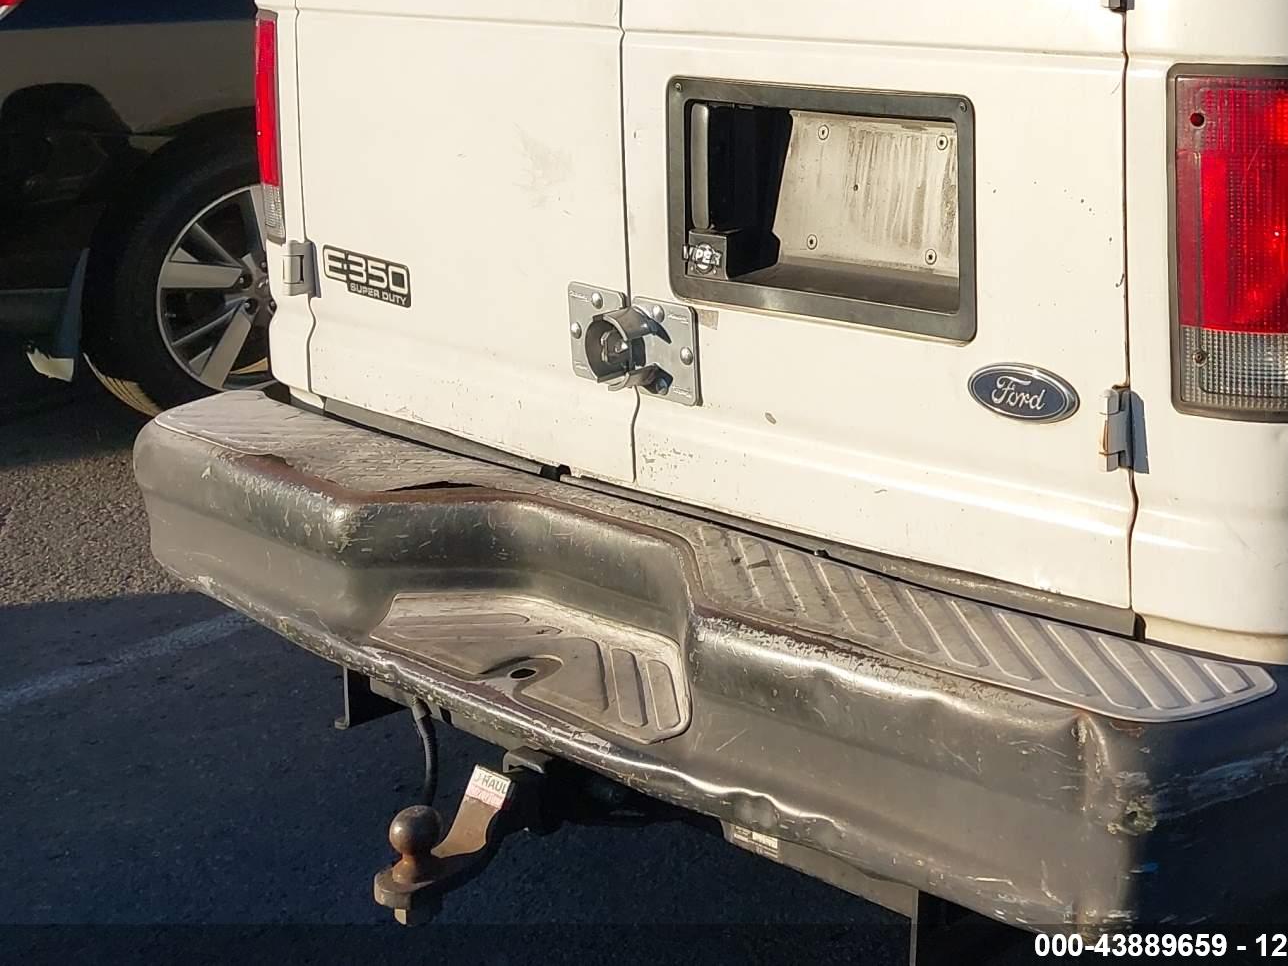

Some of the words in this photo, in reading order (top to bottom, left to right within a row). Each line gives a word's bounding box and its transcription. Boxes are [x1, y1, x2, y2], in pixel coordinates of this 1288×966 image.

[350, 282, 381, 299] SUPER
[382, 290, 408, 306] DUTY
[991, 375, 1046, 411] Ford
